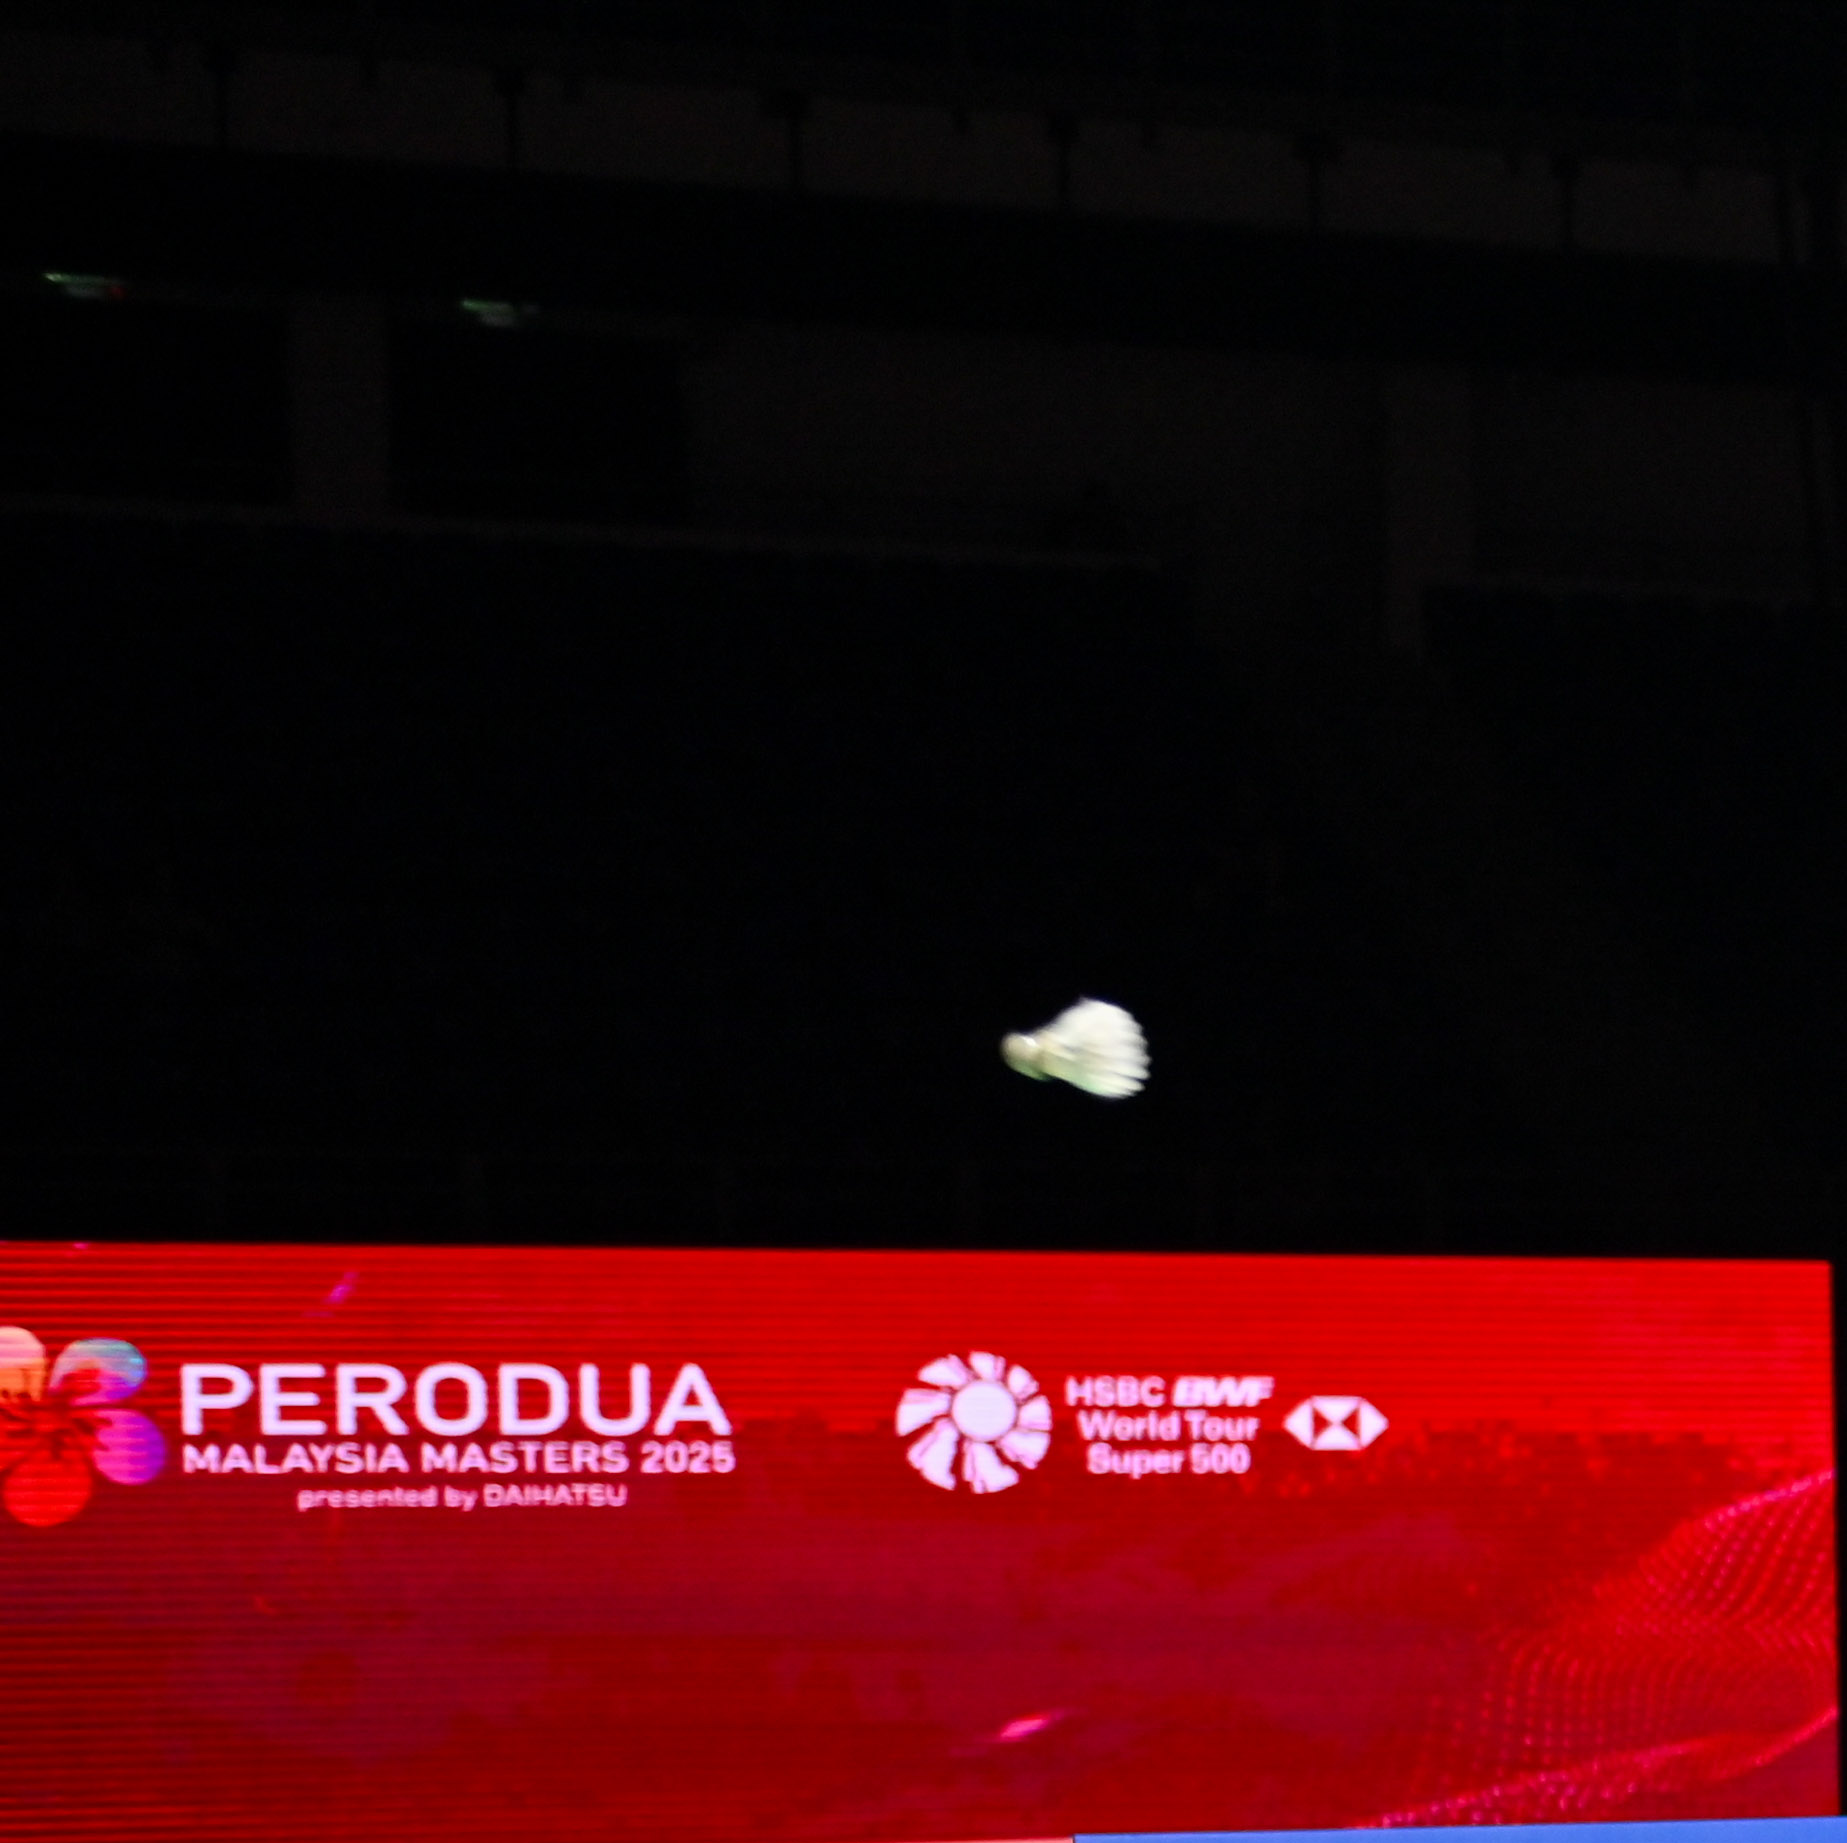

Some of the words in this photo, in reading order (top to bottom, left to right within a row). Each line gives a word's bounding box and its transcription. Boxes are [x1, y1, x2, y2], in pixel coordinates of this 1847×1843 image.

[180, 1362, 734, 1437] PERODUA
[1065, 1375, 1166, 1407] HSBC
[1076, 1409, 1181, 1441] World
[1184, 1409, 1260, 1441] Tour
[182, 1442, 411, 1474] MALAYSIA
[420, 1441, 630, 1474] MASTERS
[640, 1440, 736, 1474] 2025
[1087, 1442, 1185, 1480] Super
[1190, 1442, 1251, 1474] 500
[297, 1485, 438, 1512] presented
[444, 1484, 478, 1512] by
[483, 1482, 628, 1508] DAIHATSU
